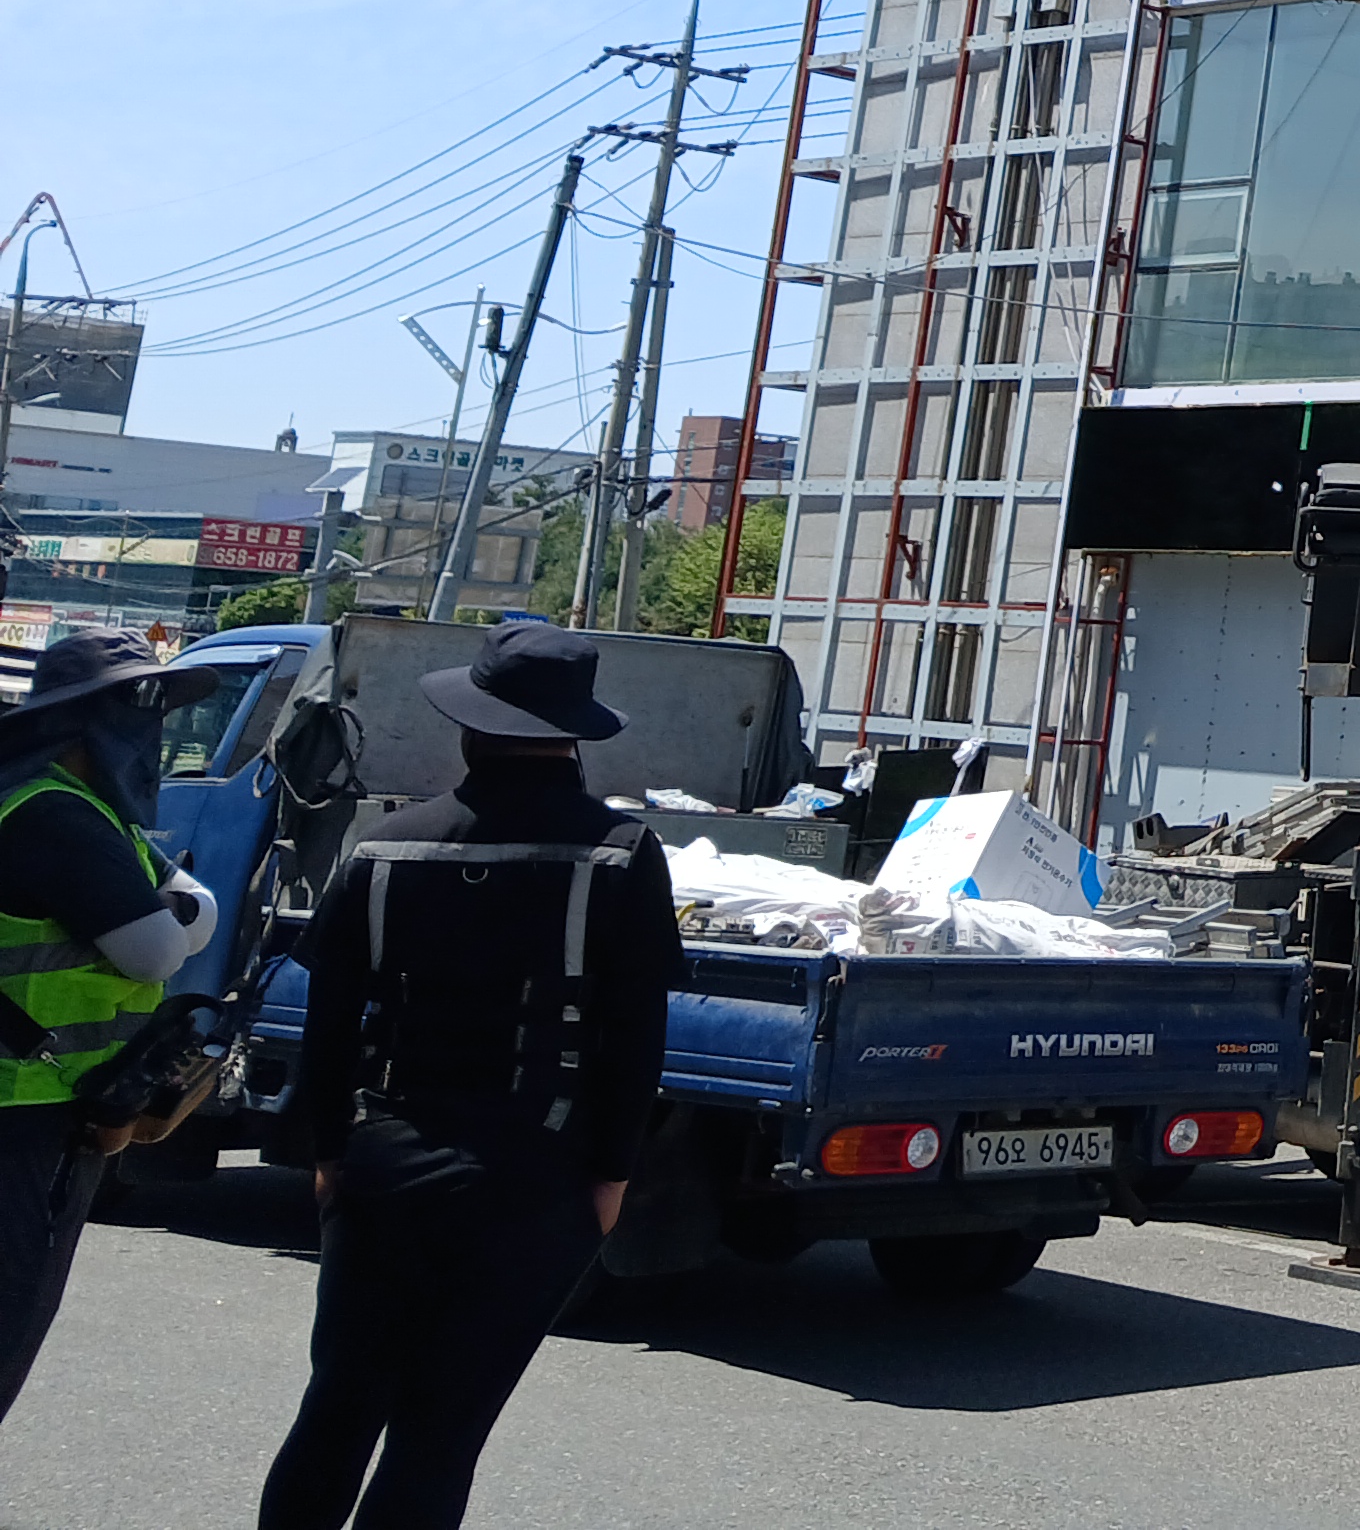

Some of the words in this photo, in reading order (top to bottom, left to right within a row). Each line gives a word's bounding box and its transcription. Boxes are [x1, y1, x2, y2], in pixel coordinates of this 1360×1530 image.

[202, 522, 301, 547] 스크린골프
[213, 546, 298, 570] 658-1872
[1010, 1033, 1155, 1058] HYUNDAI
[977, 1134, 1026, 1166] 96오
[1039, 1131, 1100, 1163] 6945
